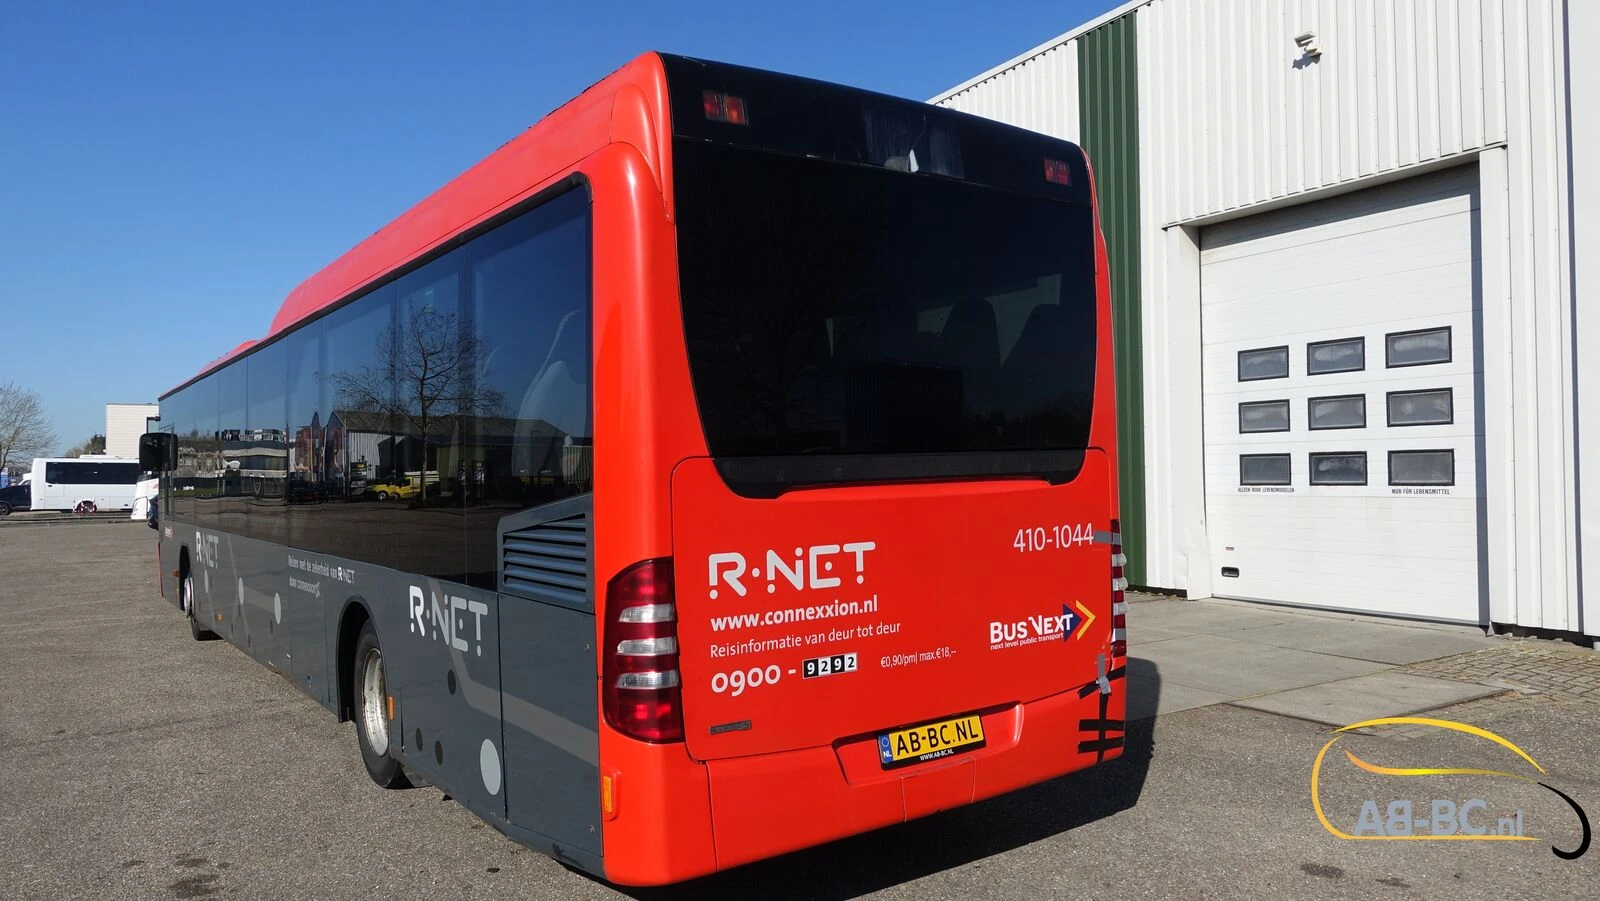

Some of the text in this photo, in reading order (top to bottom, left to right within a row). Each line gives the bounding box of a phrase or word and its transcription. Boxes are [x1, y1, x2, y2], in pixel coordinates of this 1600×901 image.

[1013, 522, 1095, 553] 410-1044
[710, 594, 878, 631] www.connexxion.nl
[710, 622, 901, 658] Reisinformatie van deur tot deur
[1004, 640, 1019, 649] level
[1020, 637, 1038, 647] public
[1038, 632, 1064, 643] transport
[711, 664, 781, 697] 0900
[805, 655, 857, 676] 9292
[883, 719, 979, 758] NL AB-BC.NL
[919, 748, 955, 761] WWW.AB-BC.NL
